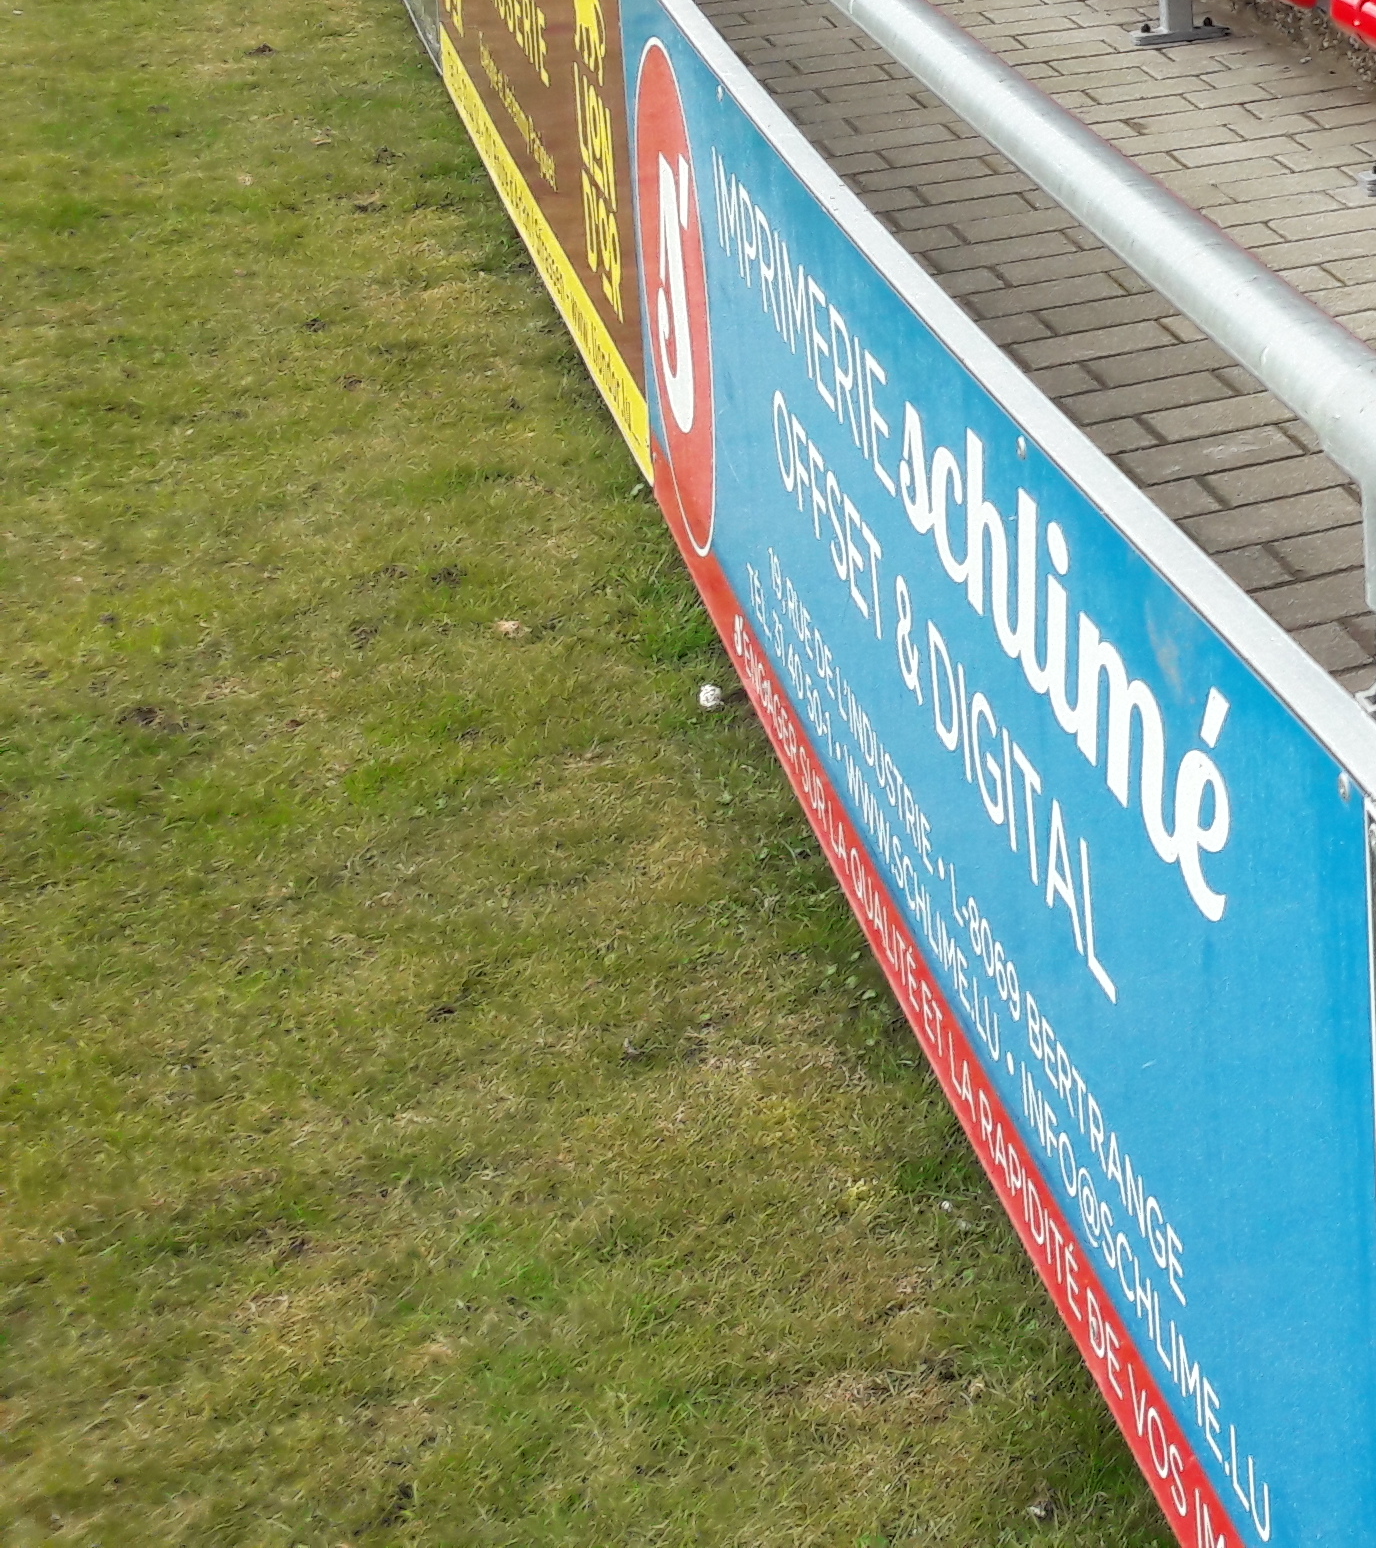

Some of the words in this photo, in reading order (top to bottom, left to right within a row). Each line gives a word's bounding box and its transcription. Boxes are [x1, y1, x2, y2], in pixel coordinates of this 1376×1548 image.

[573, 60, 618, 212] LION
[581, 168, 624, 324] D'OR
[712, 145, 896, 497] IMPRIMERIE
[900, 401, 1230, 922] schlimé
[773, 390, 882, 640] OFFSET
[896, 575, 923, 705] &
[928, 619, 1117, 1005] DIGITAL
[768, 547, 786, 614] 19,
[786, 577, 813, 660] RUE
[815, 628, 836, 700] DE
[836, 667, 934, 875] L'INDUSTRIE
[950, 863, 1020, 1022] L-8069
[1026, 991, 1187, 1308] BERTRANGE
[772, 610, 787, 666] 31
[788, 644, 804, 700] 40
[805, 674, 833, 757] 50-1
[844, 744, 999, 1061] WWW.SCHLIME.LU
[1021, 1061, 1270, 1543] INFO@SCHLIME.LU
[800, 746, 827, 832] SUR
[828, 800, 849, 875] LA
[850, 847, 919, 1012] QUALITÉ
[921, 980, 942, 1057] ET
[949, 1031, 976, 1123] LA
[979, 1089, 1082, 1322] RAPIDITÉ
[1087, 1286, 1124, 1401] DE
[1127, 1363, 1188, 1517] VOS
